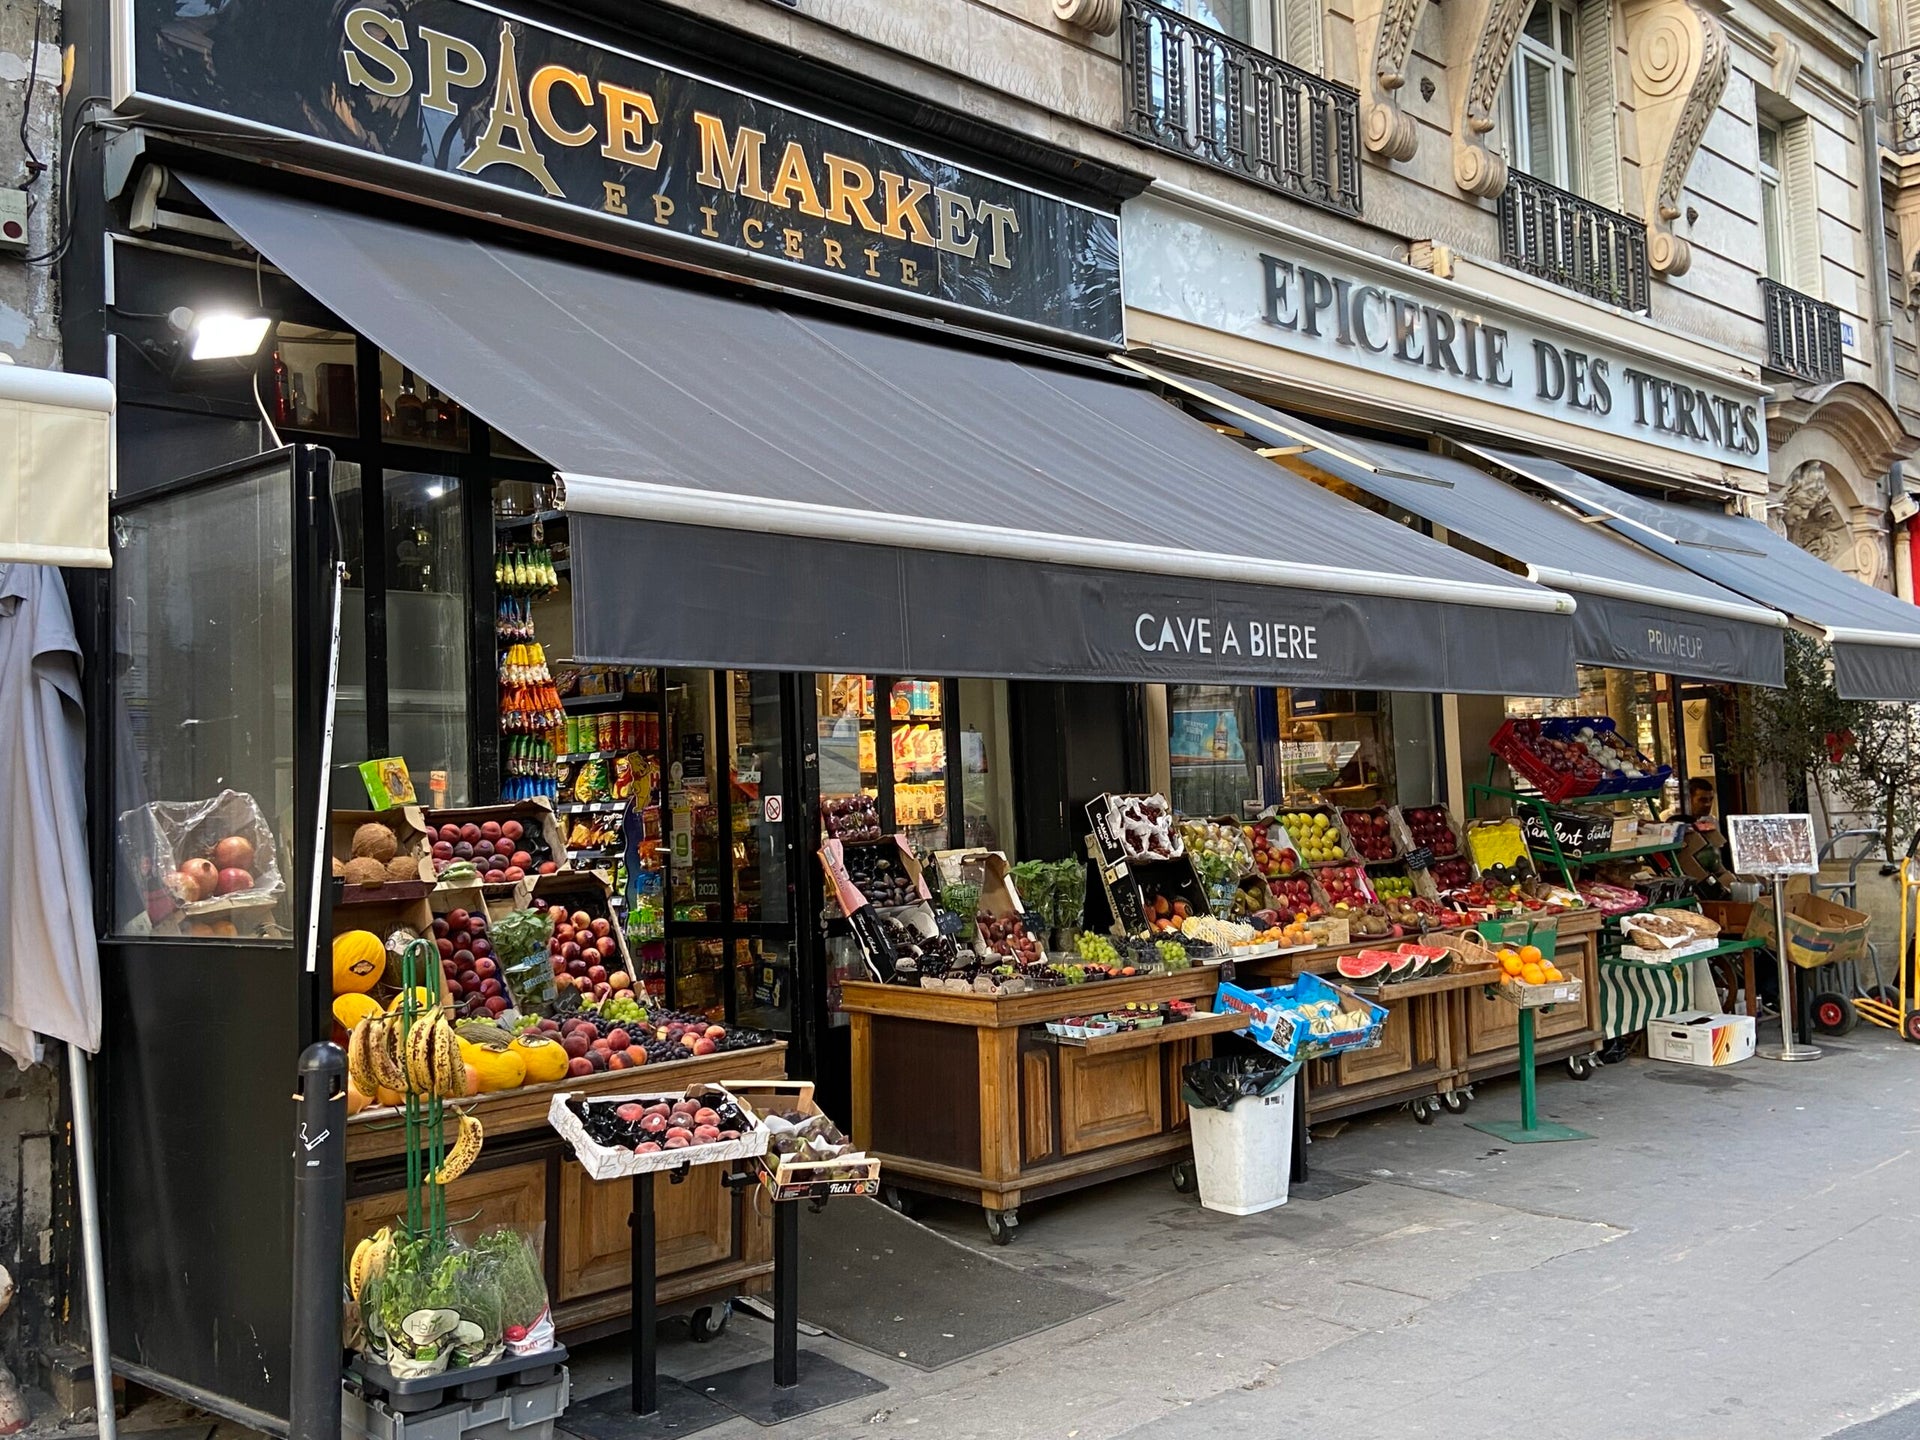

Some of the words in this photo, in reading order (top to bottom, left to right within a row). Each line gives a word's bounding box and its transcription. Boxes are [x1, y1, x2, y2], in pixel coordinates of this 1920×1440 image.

[343, 7, 663, 198] SPACE
[693, 112, 1020, 270] MARKET
[602, 180, 919, 288] EPICERIE
[1258, 252, 1514, 389] EPICERIE
[1532, 338, 1614, 417] DES
[1622, 366, 1761, 457] TERNES
[1135, 612, 1212, 654] CAVE
[1221, 621, 1241, 655] A
[1249, 621, 1318, 659] BIERE
[1647, 629, 1704, 660] PRIMEUR
[1095, 812, 1113, 850] GLAMOUR
[698, 883, 719, 896] 2021
[829, 1182, 852, 1194] Fichi
